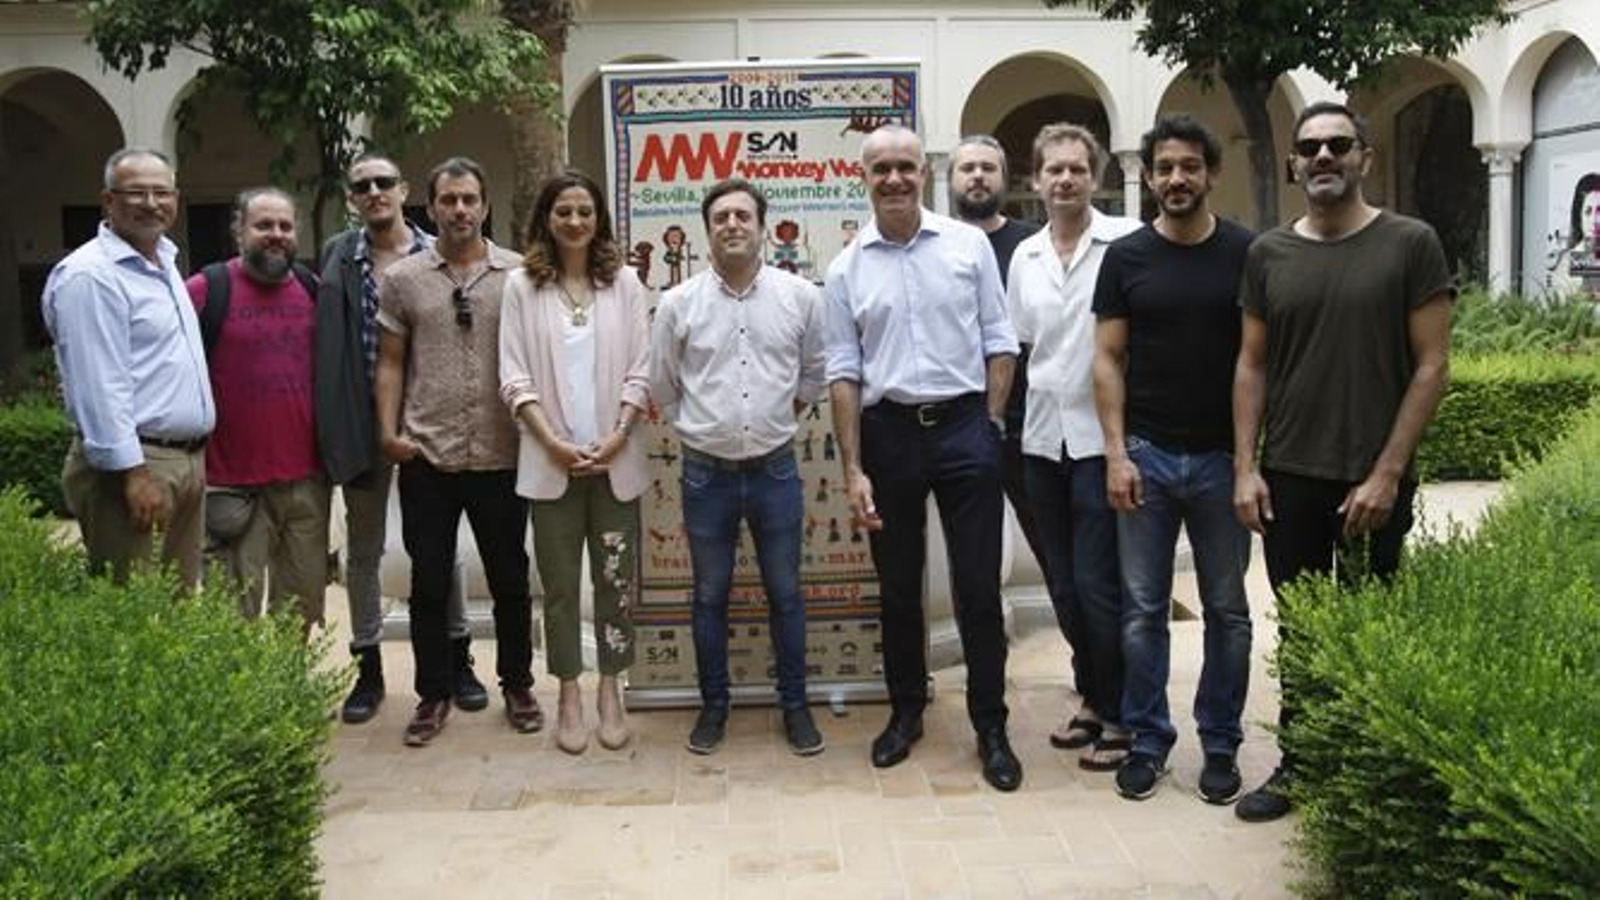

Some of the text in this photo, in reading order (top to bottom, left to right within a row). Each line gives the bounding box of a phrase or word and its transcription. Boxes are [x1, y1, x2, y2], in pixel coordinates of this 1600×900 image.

[721, 80, 812, 109] 10 años
[847, 181, 867, 199] 20
